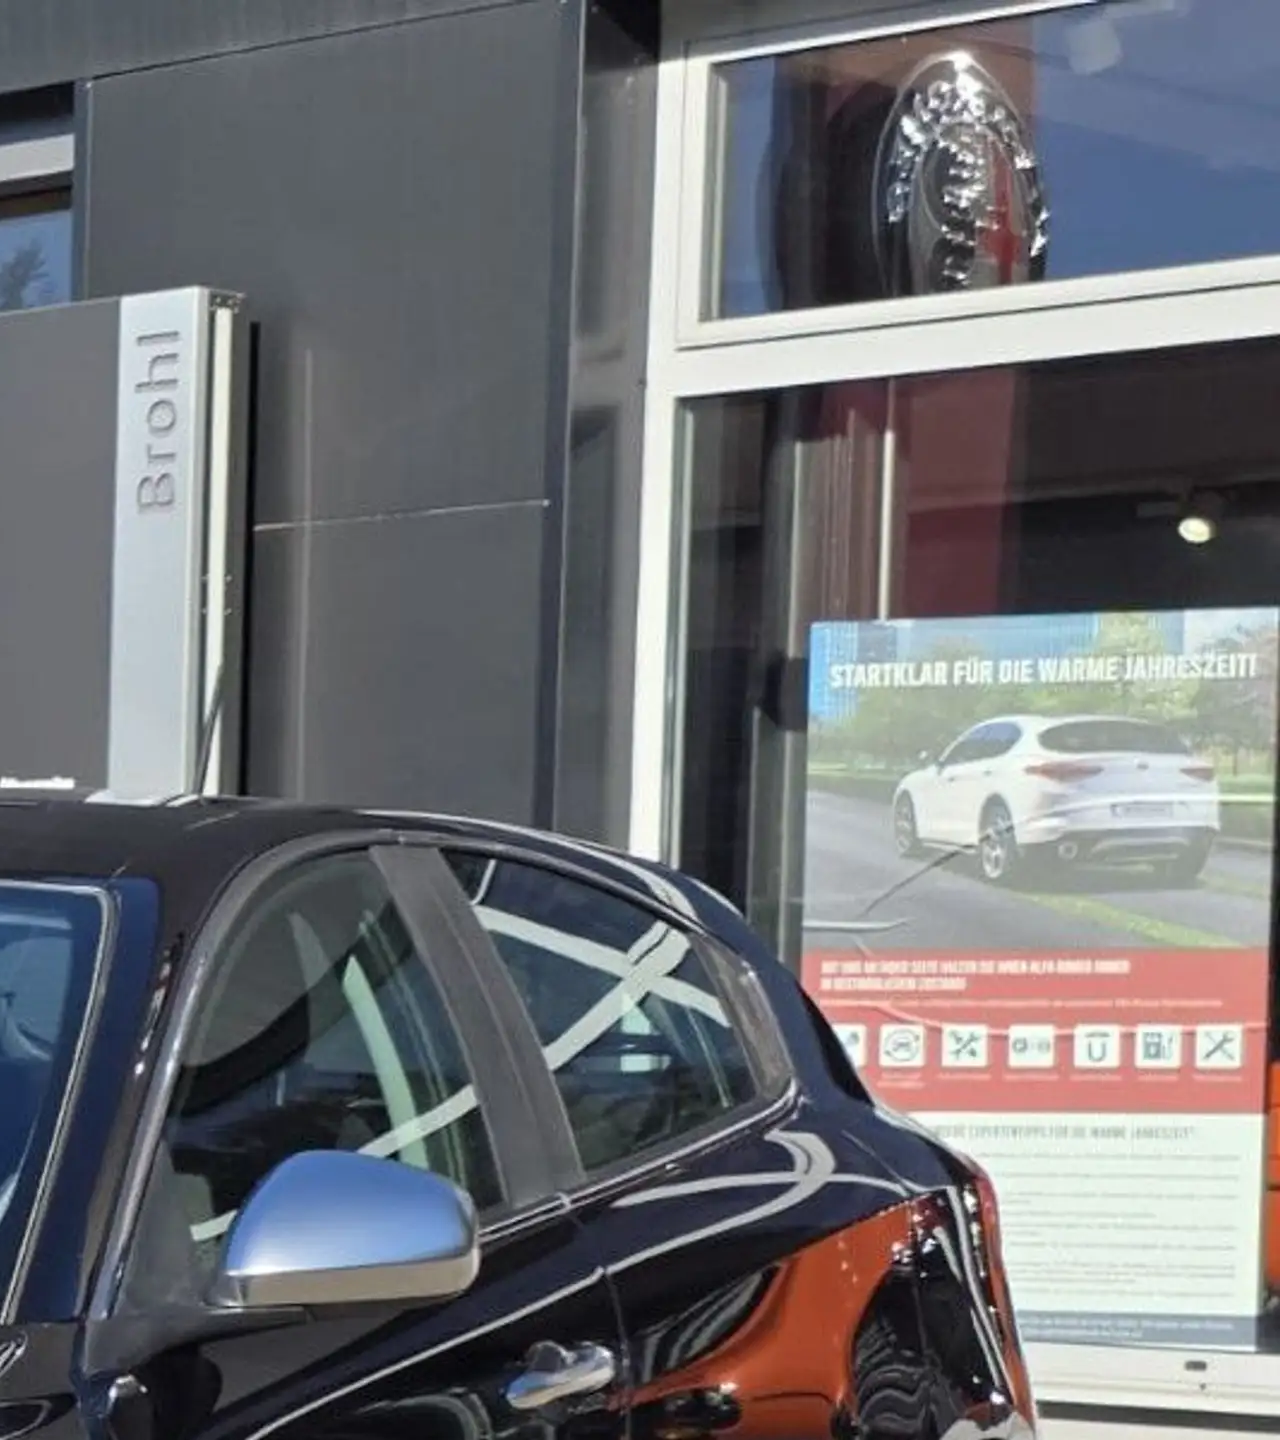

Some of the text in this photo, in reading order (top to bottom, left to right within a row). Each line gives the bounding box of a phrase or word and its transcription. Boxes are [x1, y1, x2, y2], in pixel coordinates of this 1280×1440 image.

[135, 331, 181, 513] Brohl
[830, 662, 947, 688] STARTKLAR
[953, 656, 993, 686] FÜR
[998, 660, 1034, 683] DIE
[1038, 656, 1119, 682] WARME
